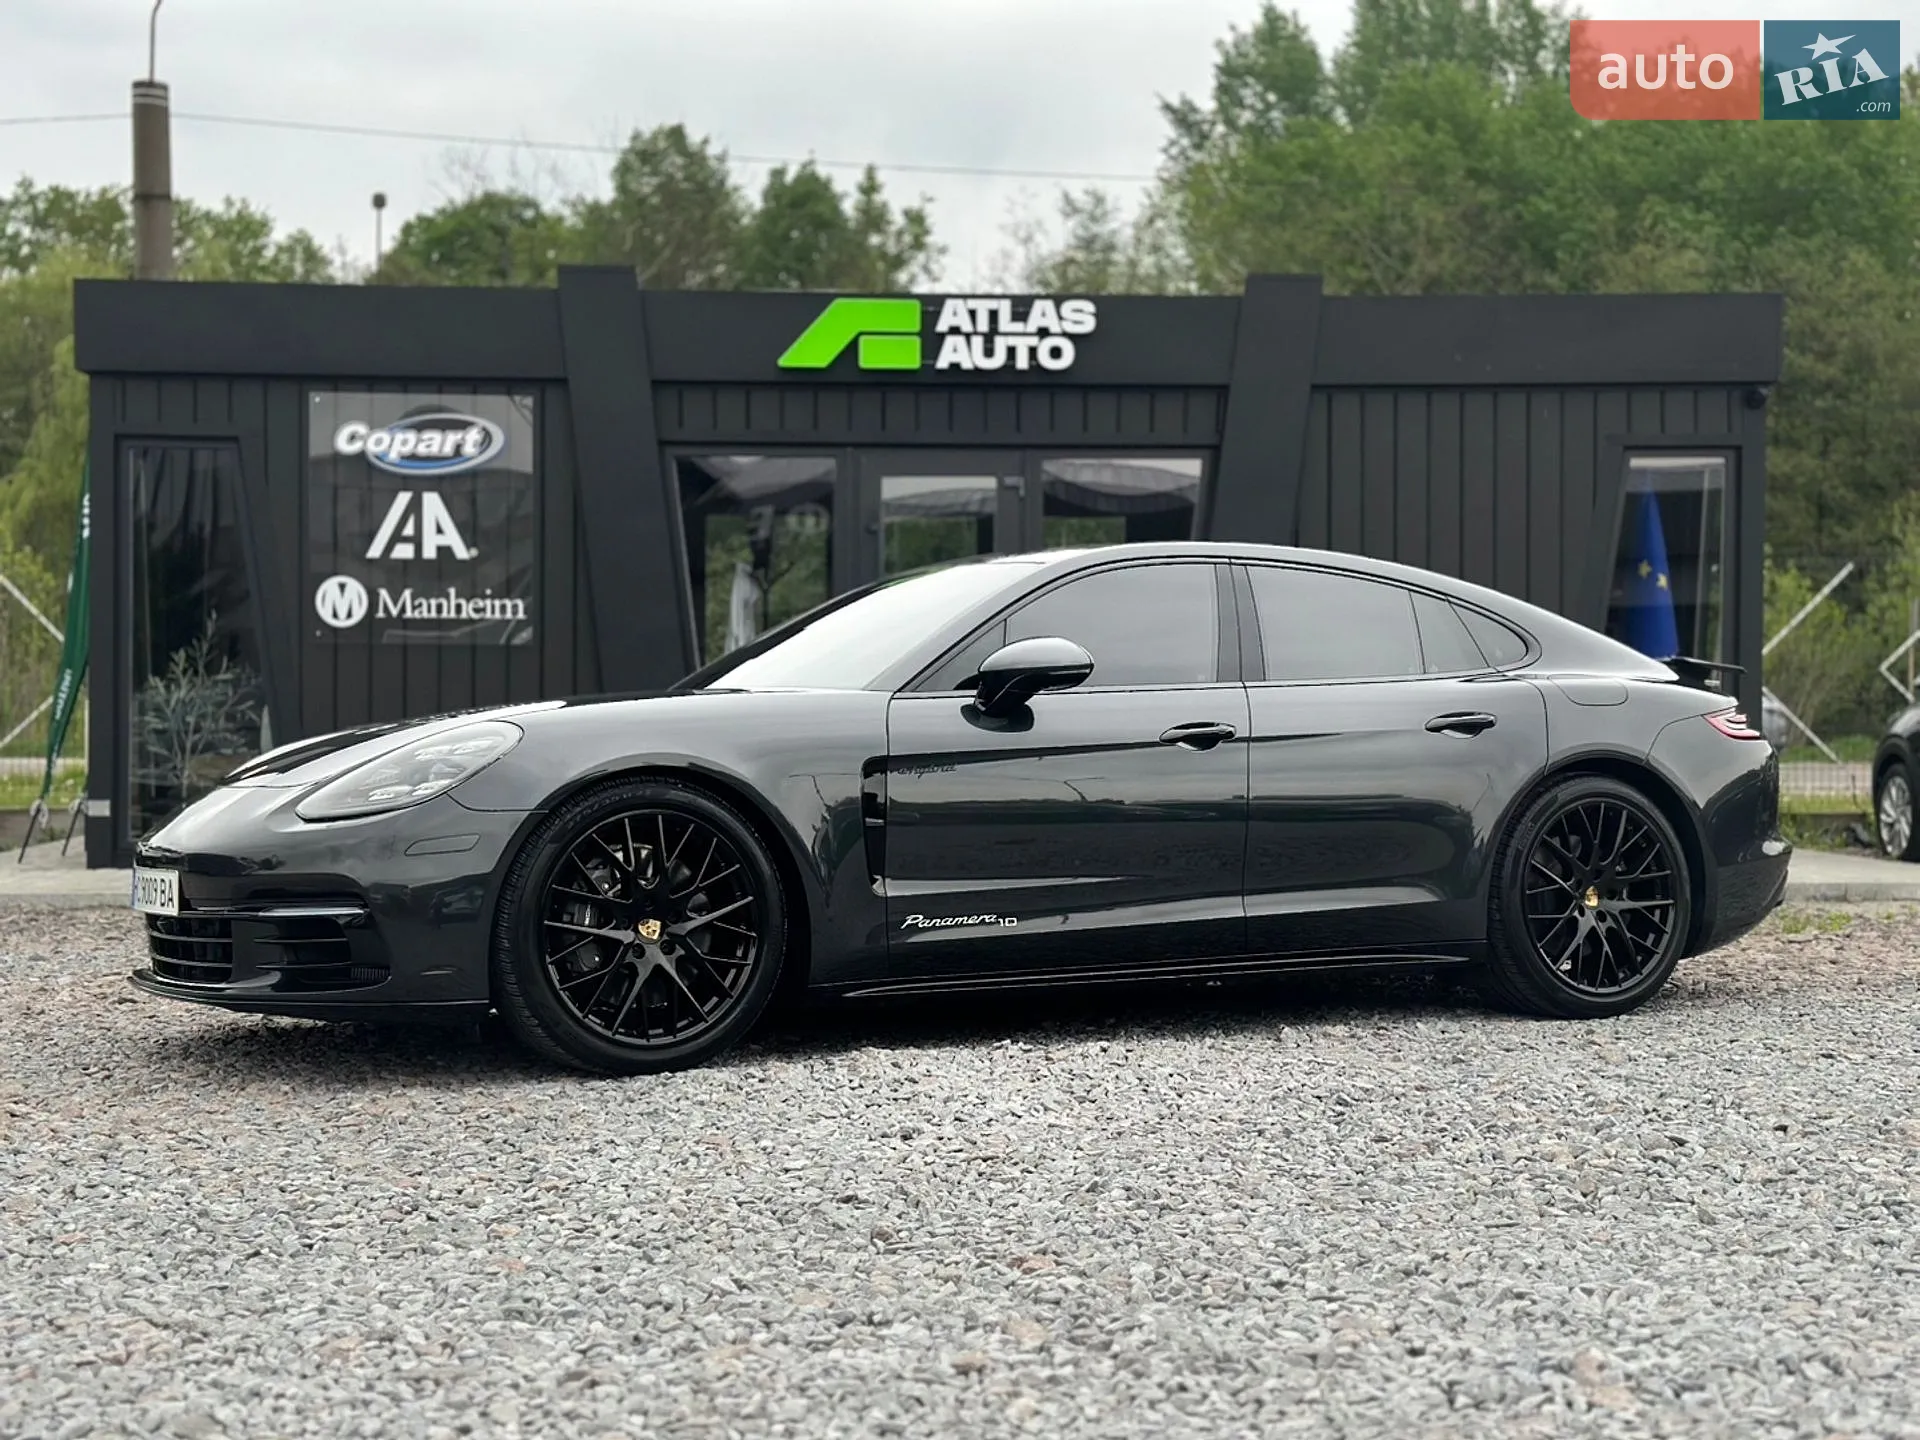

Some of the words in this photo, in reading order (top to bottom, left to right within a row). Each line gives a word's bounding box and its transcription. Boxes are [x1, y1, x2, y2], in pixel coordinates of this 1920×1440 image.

[935, 298, 1097, 334] ATLAS
[935, 335, 1076, 370] AUTO
[334, 421, 482, 462] Copart
[375, 588, 528, 620] Manheim
[901, 914, 998, 930] Panamera
